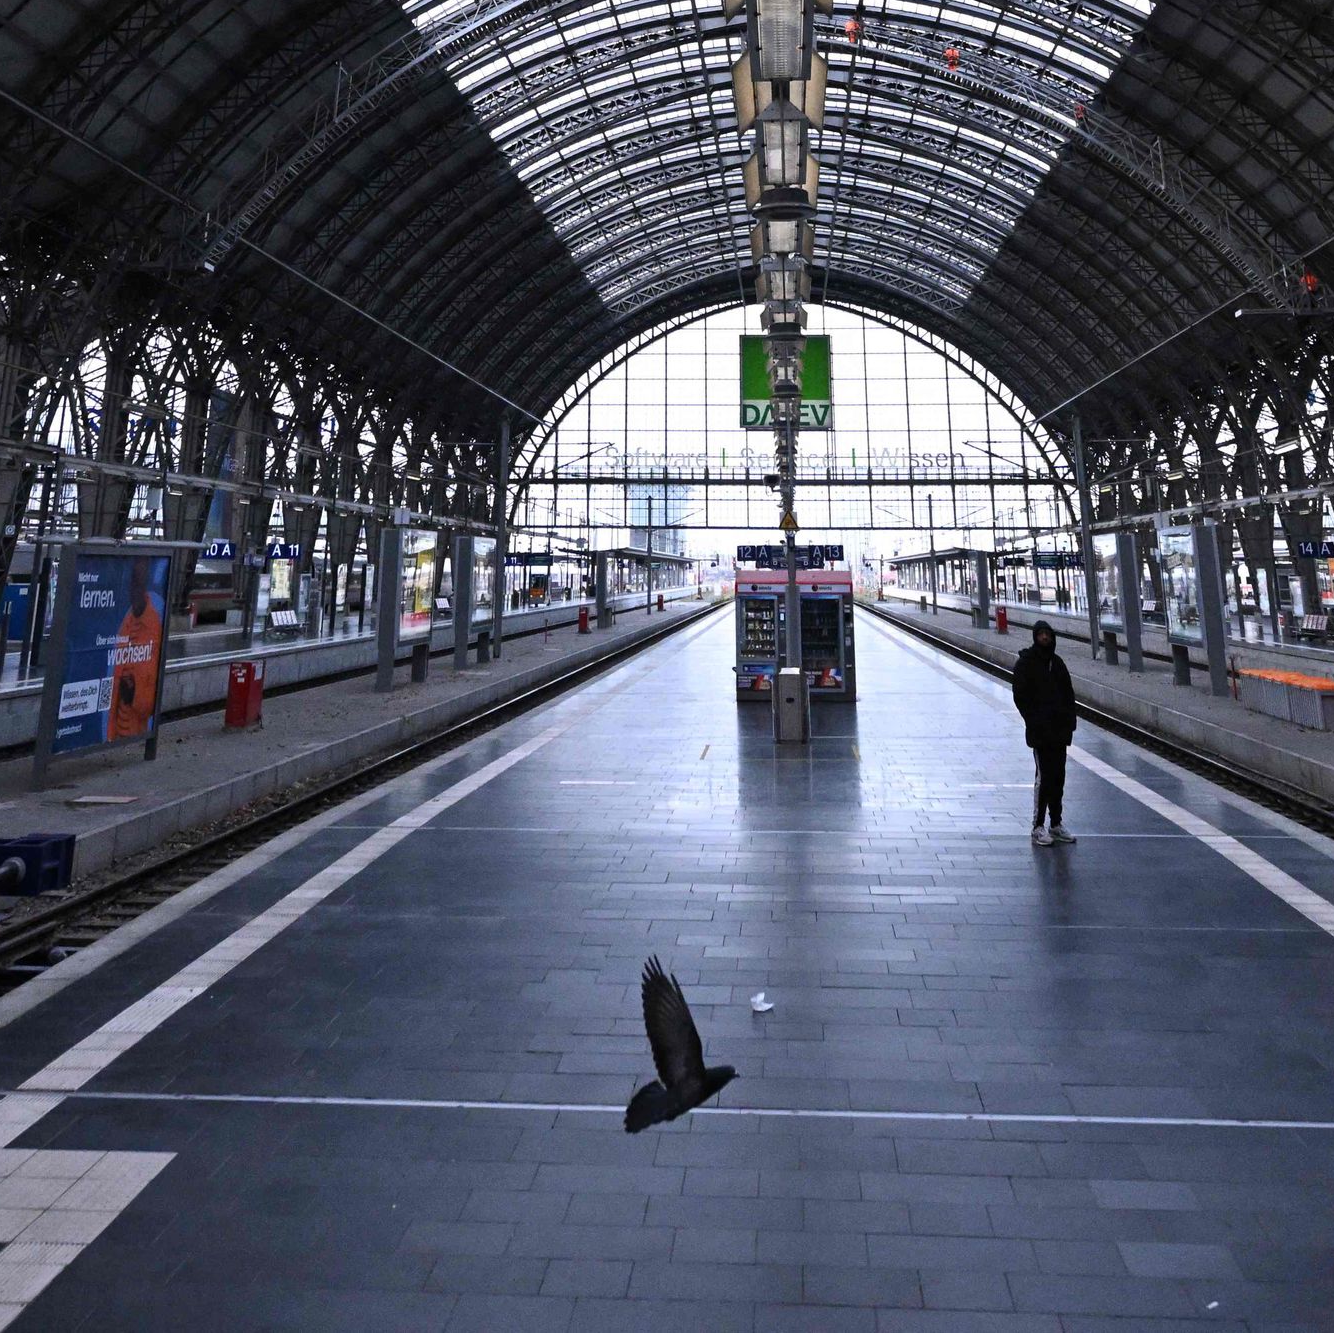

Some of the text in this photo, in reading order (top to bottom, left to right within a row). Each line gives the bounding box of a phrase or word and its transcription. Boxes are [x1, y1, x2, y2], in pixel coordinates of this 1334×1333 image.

[742, 403, 830, 426] DAEV
[605, 446, 708, 468] Software
[872, 447, 967, 468] Wissen
[222, 543, 231, 556] A
[272, 544, 300, 556] A 11
[738, 547, 752, 558] 12
[758, 547, 768, 558] A
[813, 546, 822, 558] A
[827, 546, 840, 558] 13
[1299, 542, 1331, 555] 14 A
[78, 572, 99, 583] Nicht nur
[80, 584, 115, 608] lernen.
[95, 633, 109, 647] Über
[107, 640, 154, 666] wachsen!
